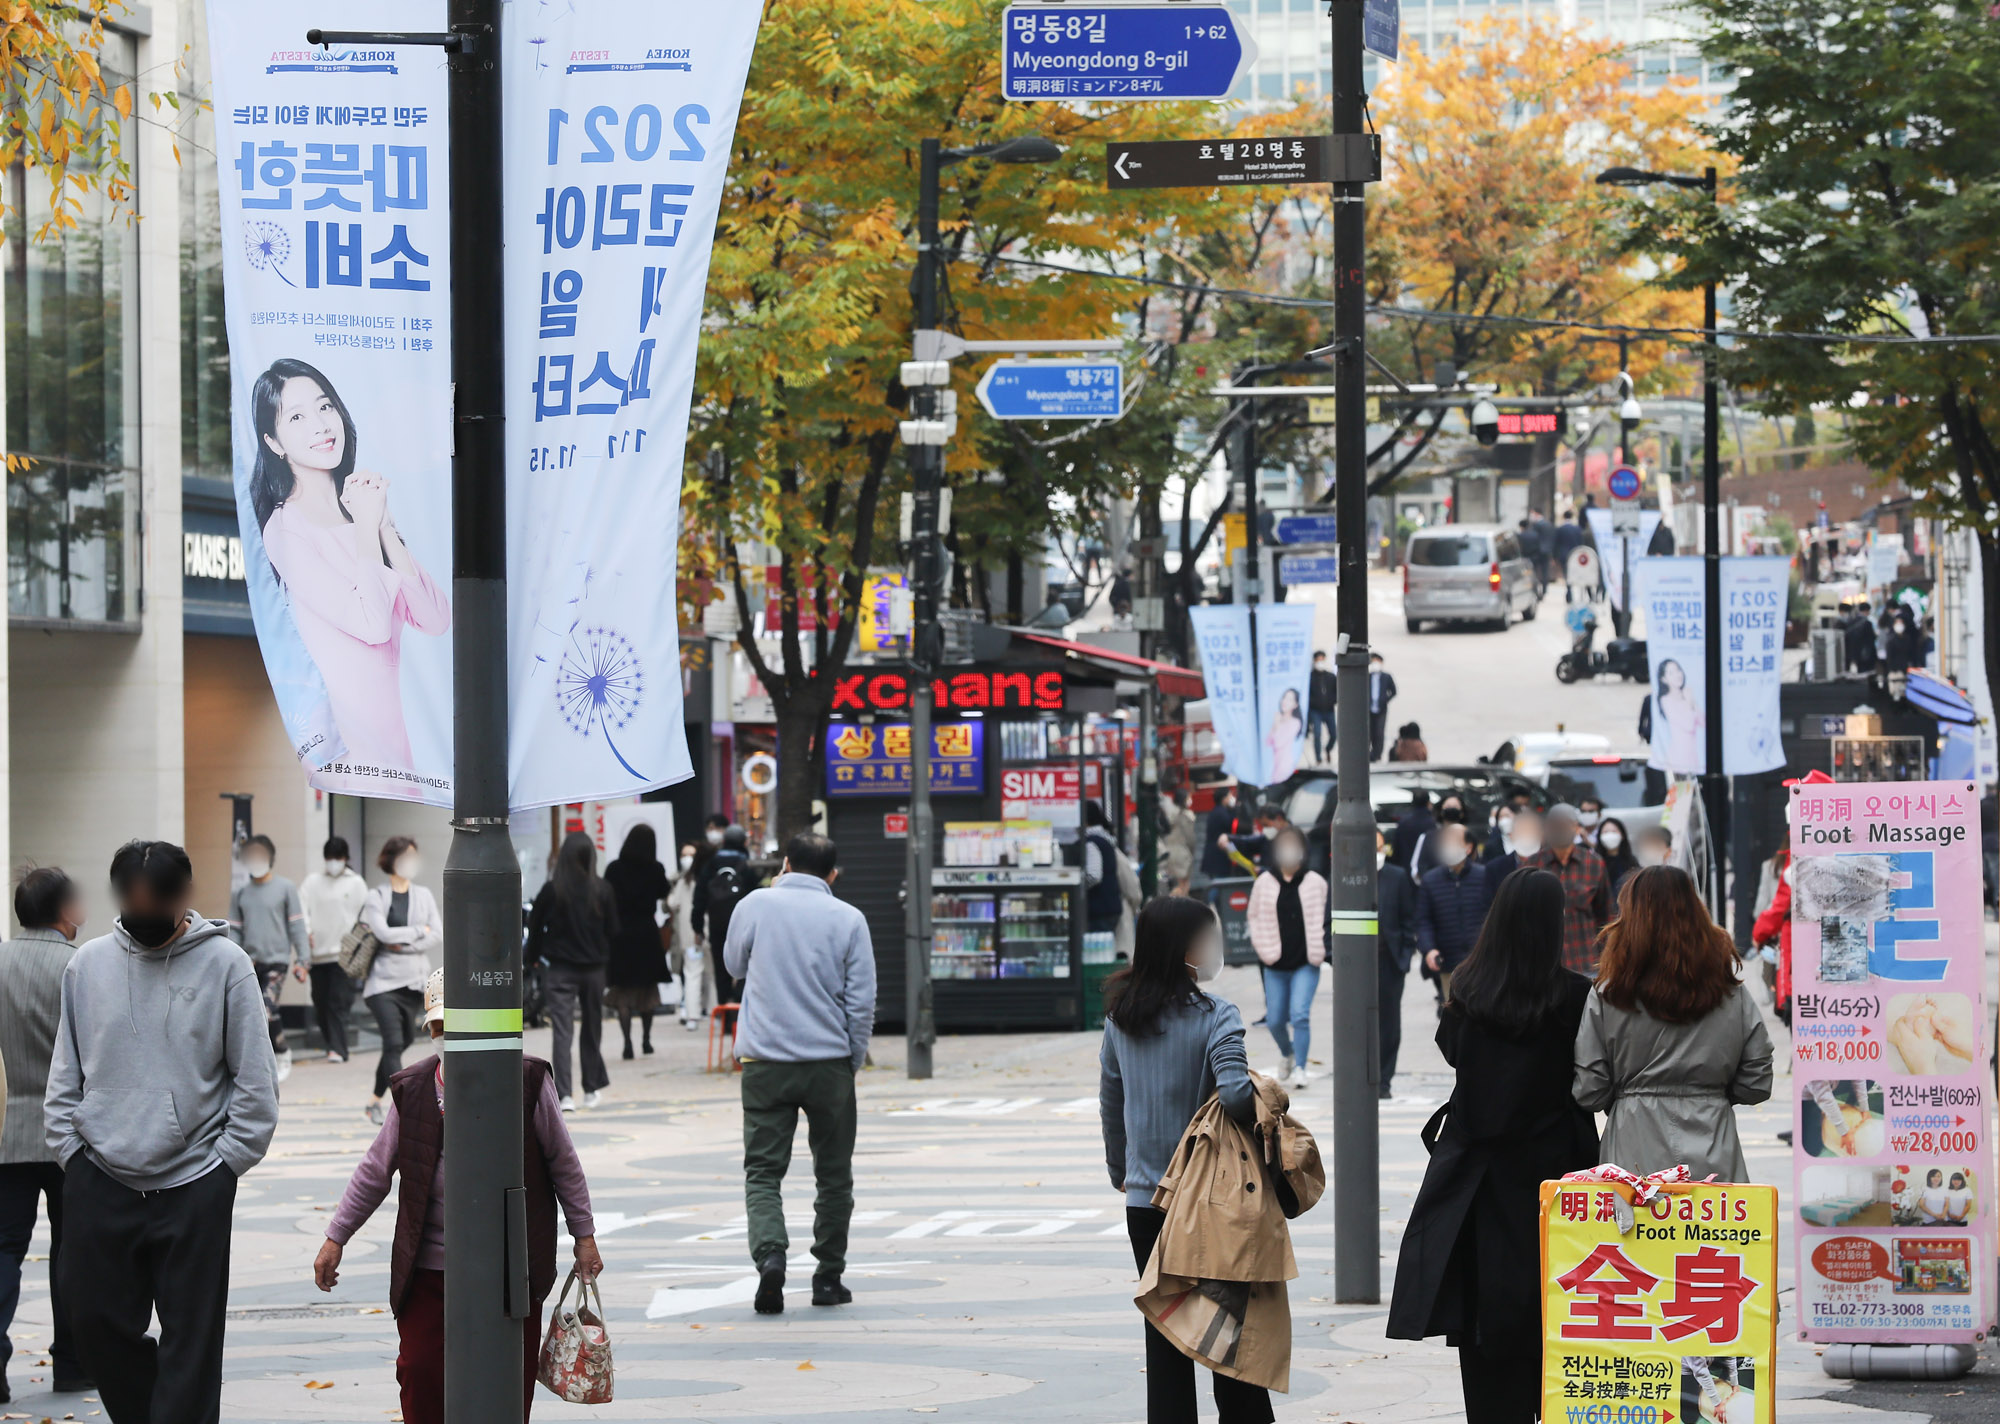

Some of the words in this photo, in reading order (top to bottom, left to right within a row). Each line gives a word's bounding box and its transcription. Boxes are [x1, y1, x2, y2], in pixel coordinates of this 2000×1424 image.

[1013, 15, 1106, 43] 명동8길
[1209, 26, 1226, 39] 62
[1013, 51, 1139, 73] Myeongdong
[1144, 50, 1188, 73] 8-gil
[1013, 80, 1064, 93] 明洞8街
[1269, 162, 1306, 171] Myeongdong
[1066, 369, 1114, 386] 명동7길
[1026, 390, 1089, 402] Myeongdong
[1091, 389, 1114, 401] 7-gil
[184, 533, 228, 579] PARIS
[862, 764, 973, 780] 국제전카드
[1003, 772, 1055, 798] SIM
[1801, 797, 1852, 822] 明洞
[1863, 794, 1964, 820] 오아시스
[1801, 825, 1852, 844] Foot
[1868, 823, 1965, 846] Massage
[470, 971, 513, 986] 서울중구
[1797, 994, 1880, 1019] 발(45分)
[1797, 1041, 1880, 1062] ₩18,000
[1891, 1131, 1977, 1154] ₩28,000
[1651, 1192, 1747, 1221] Oasis
[1636, 1224, 1676, 1240] Foot
[1684, 1225, 1761, 1245] Massage
[1556, 1243, 1760, 1344] 全身
[1812, 1303, 1924, 1316] TEL.02-773-3008
[1932, 1305, 1971, 1315] 연중무휴
[1562, 1356, 1673, 1379] 전신+발(60分)
[1564, 1381, 1672, 1400] 全身按摩+足疗
